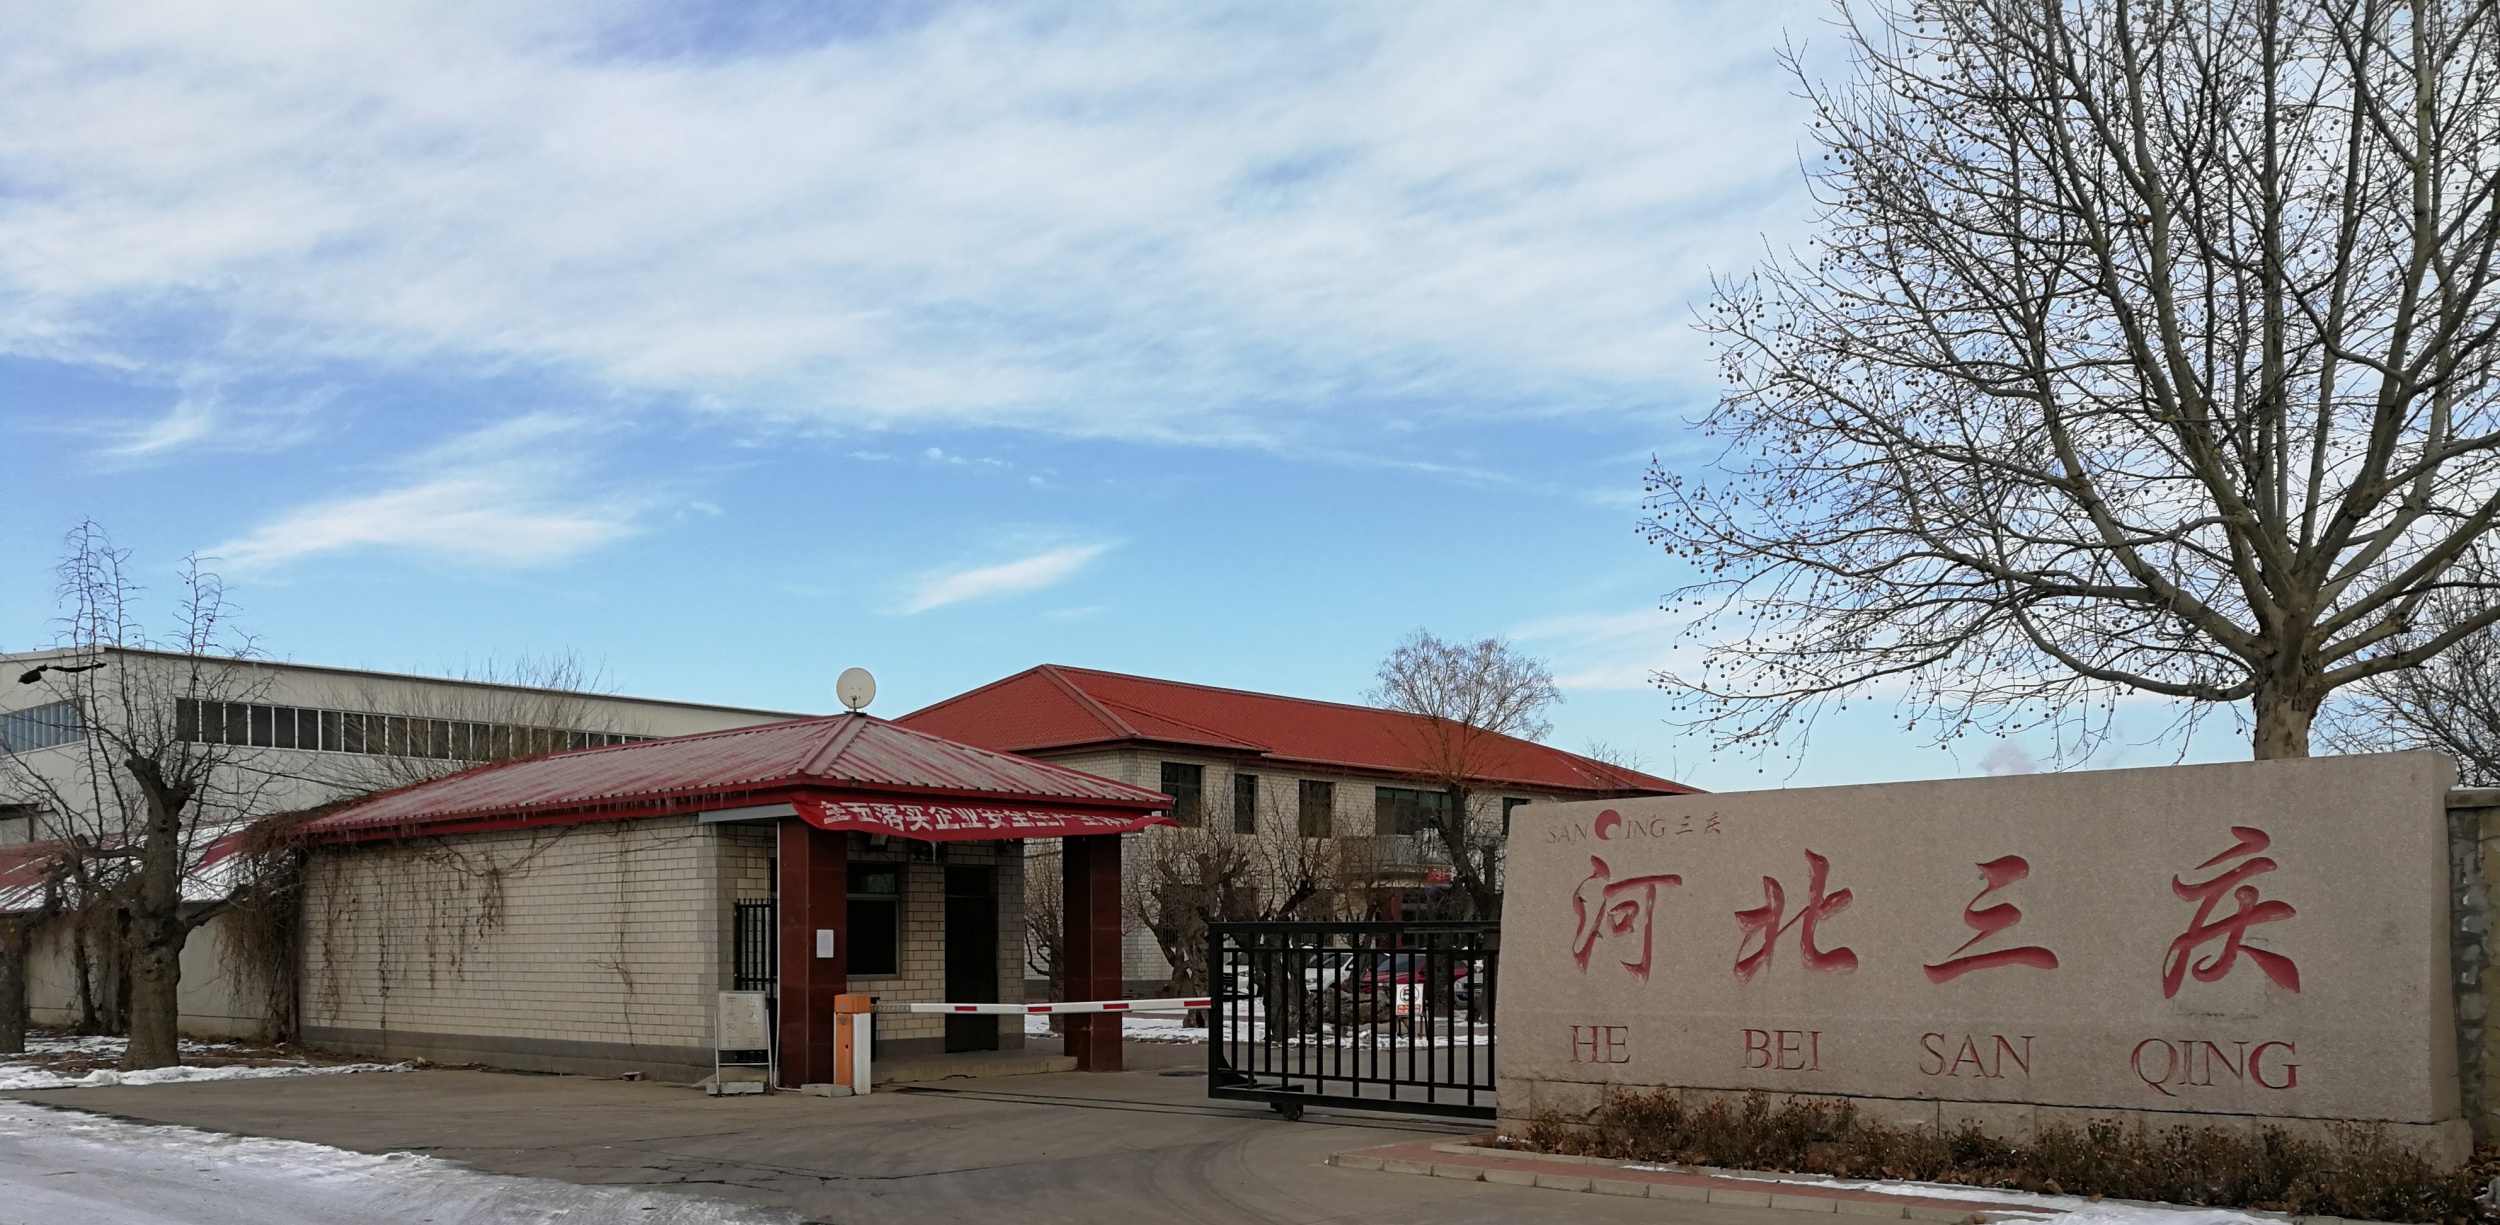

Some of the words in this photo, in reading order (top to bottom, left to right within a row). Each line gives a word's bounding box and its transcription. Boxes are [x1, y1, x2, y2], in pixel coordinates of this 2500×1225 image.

[1546, 823, 1589, 844] SAN
[1675, 811, 1722, 835] 三庆
[1571, 826, 2301, 999] 河北三庆
[1569, 1024, 1631, 1064] HE
[1741, 1028, 1824, 1072] BEI
[1918, 1032, 2036, 1080] SAN
[2130, 1038, 2301, 1097] QING
